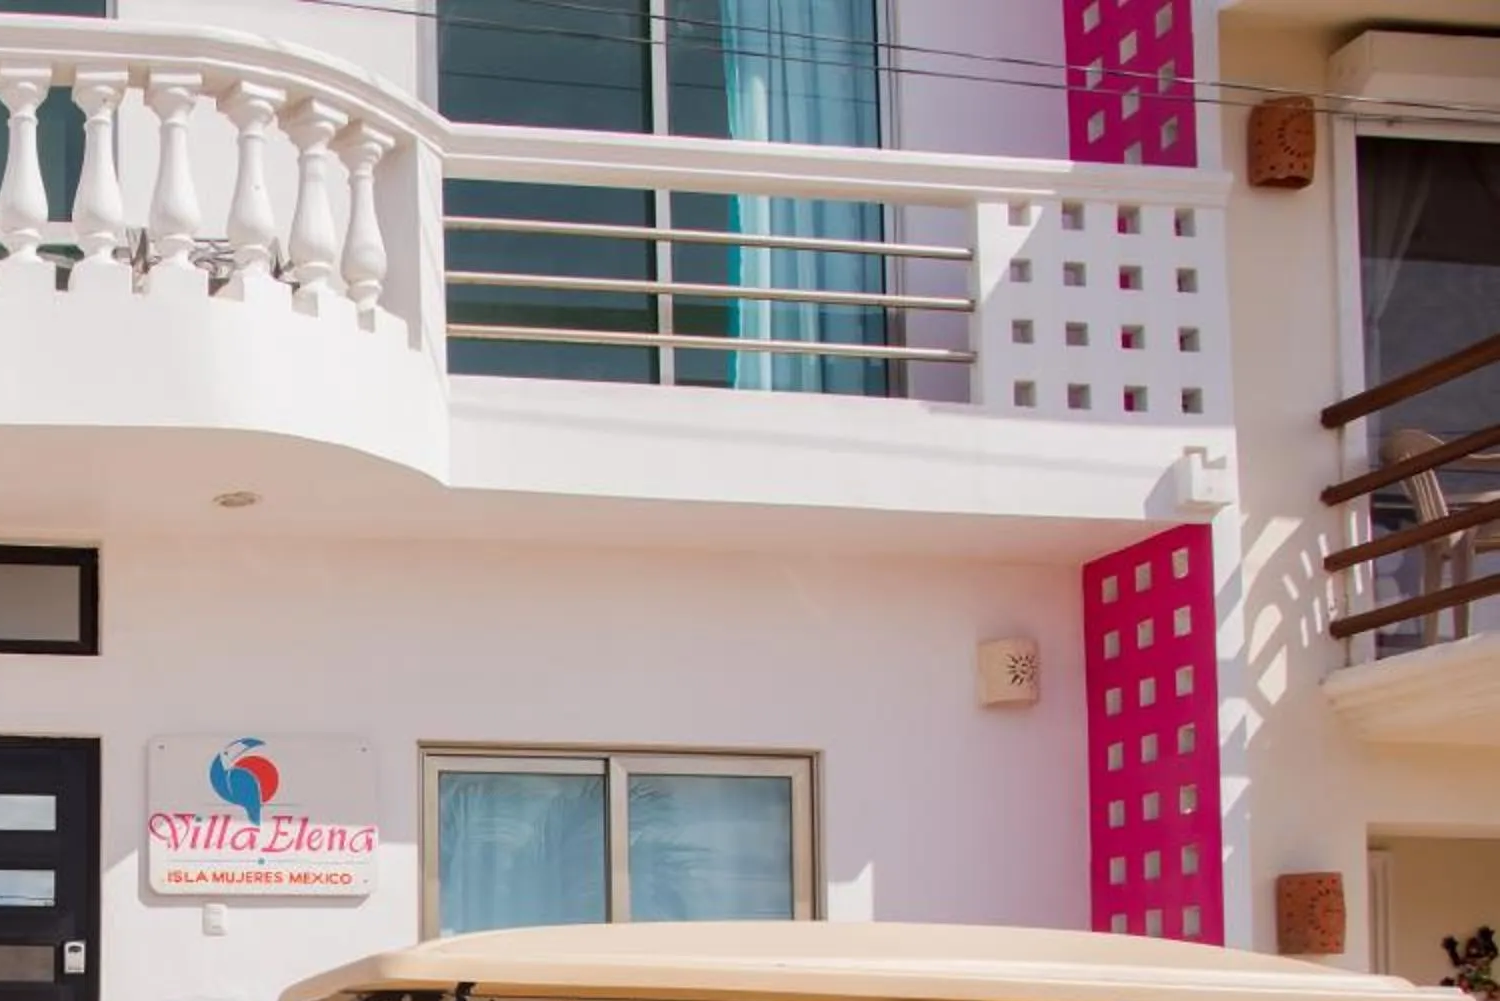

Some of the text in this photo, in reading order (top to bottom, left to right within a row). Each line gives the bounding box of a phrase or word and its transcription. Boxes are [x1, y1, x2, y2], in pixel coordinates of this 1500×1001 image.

[148, 813, 376, 853] Villa Elena
[167, 871, 353, 885] ISLA MUJERES MEXICO
